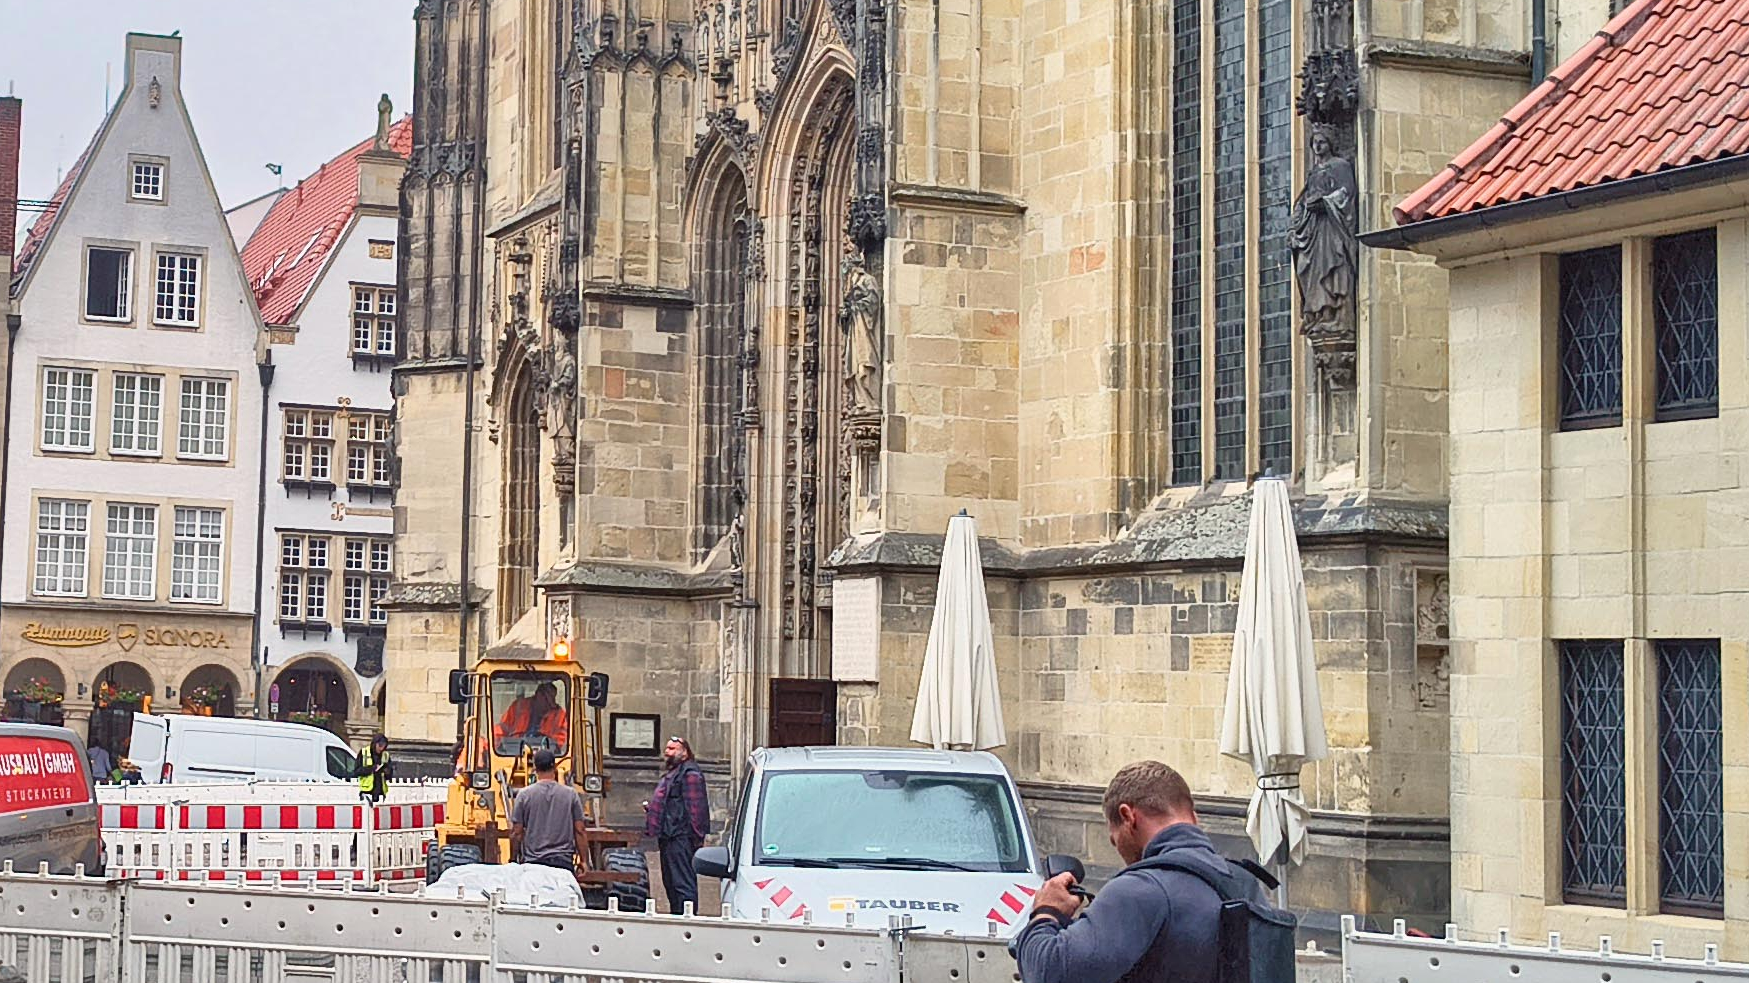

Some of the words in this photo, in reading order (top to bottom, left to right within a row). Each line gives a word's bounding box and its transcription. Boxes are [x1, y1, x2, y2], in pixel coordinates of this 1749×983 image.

[144, 627, 231, 649] SIGNORA
[6, 787, 72, 803] STUCKATEUR
[855, 899, 961, 913] TAUBER
